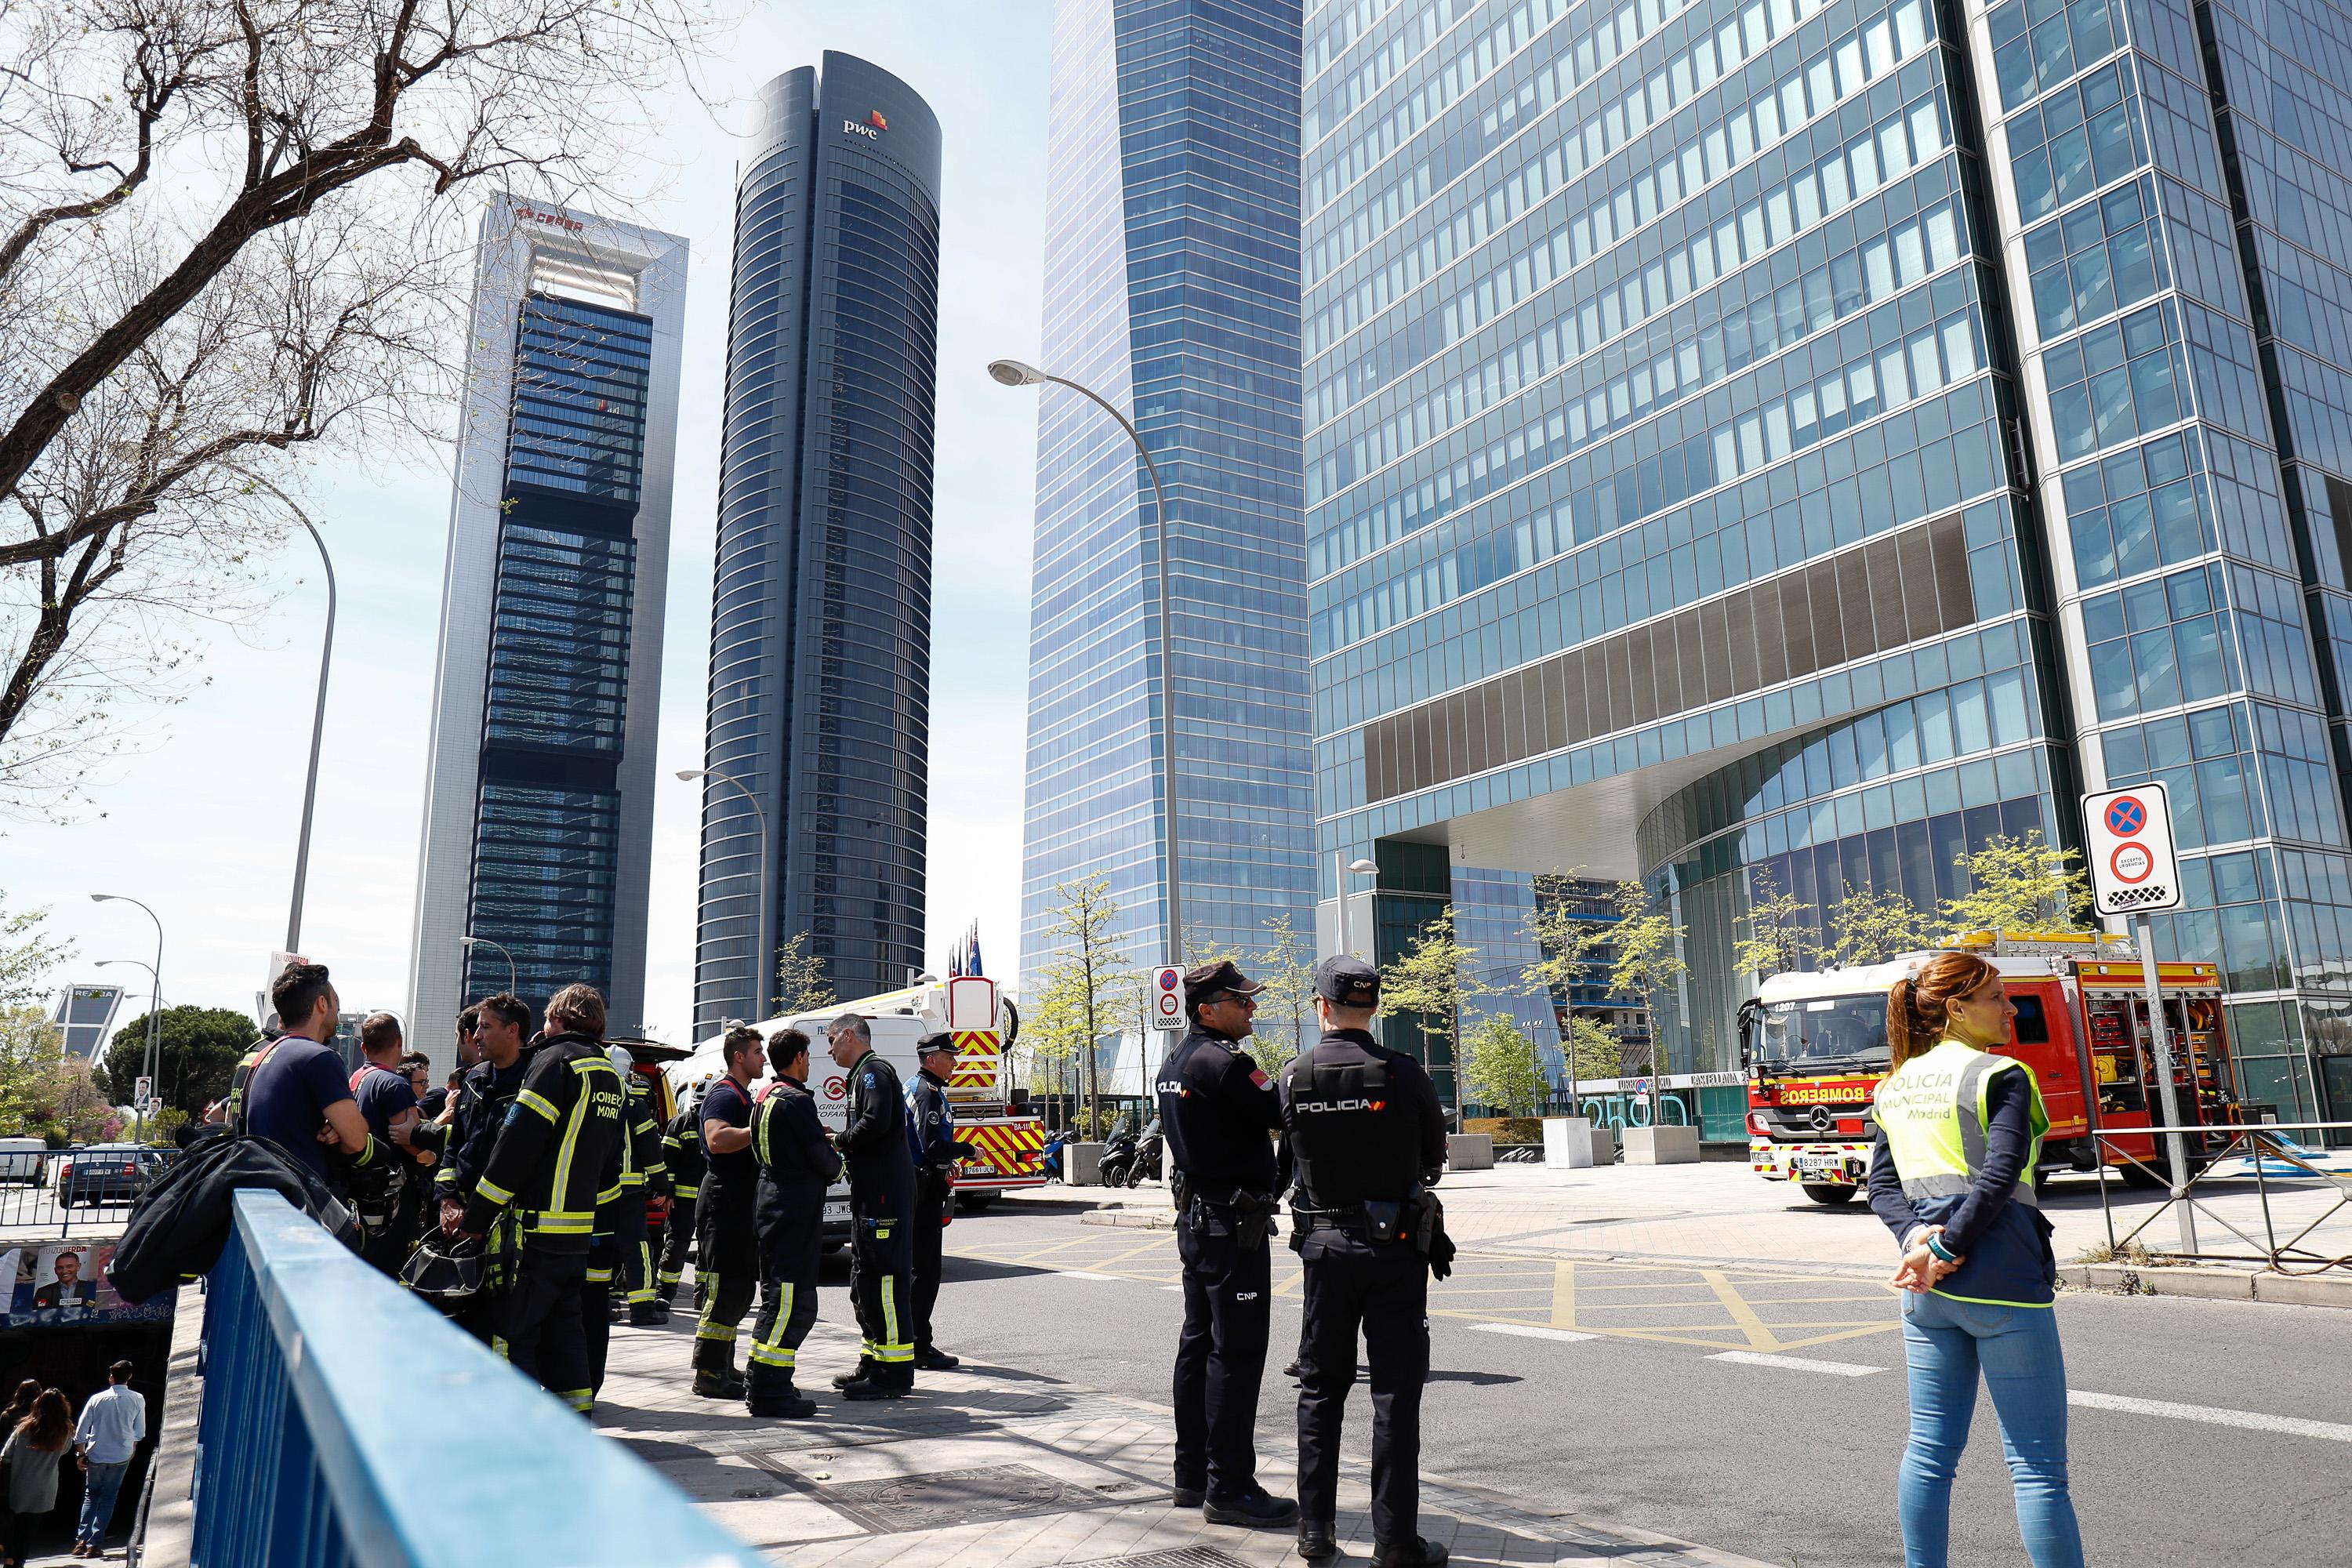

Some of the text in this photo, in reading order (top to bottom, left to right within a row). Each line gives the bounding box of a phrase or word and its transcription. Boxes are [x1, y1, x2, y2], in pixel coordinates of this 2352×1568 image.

[843, 120, 877, 140] pwc
[1774, 1001, 1795, 1013] 1207
[1296, 1098, 1371, 1113] POLICIA
[1882, 1092, 1951, 1112] MUNICIPAL
[1907, 1107, 1951, 1120] Madrid
[1804, 1158, 1822, 1167] 8287
[50, 1246, 87, 1254] IZQUIERDA
[1236, 1292, 1258, 1301] CNP
